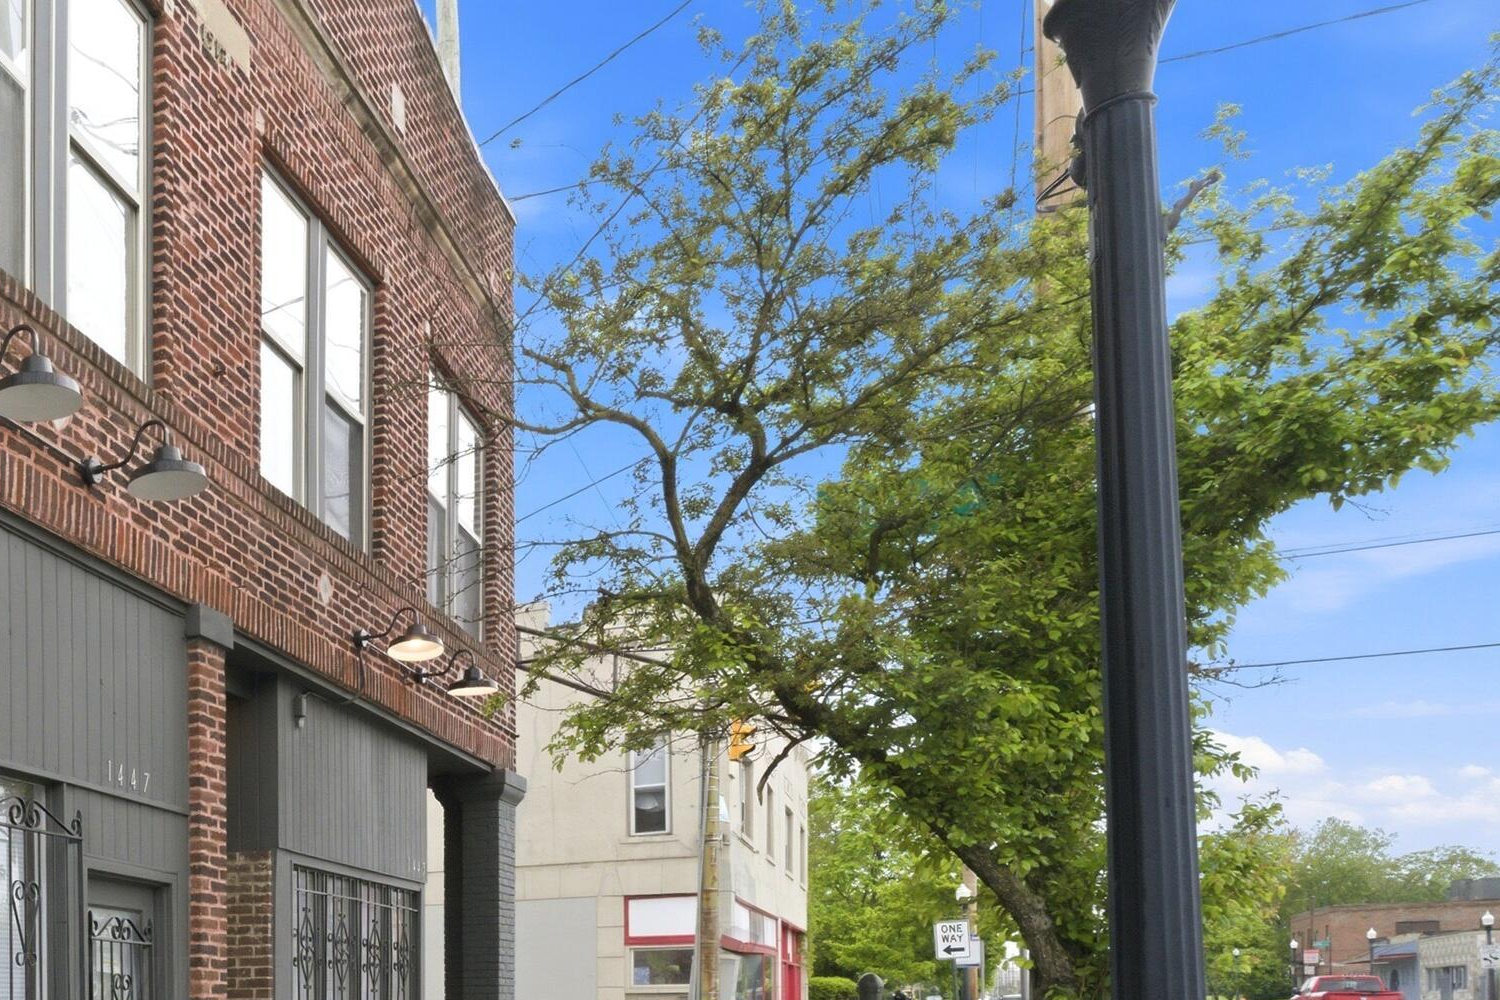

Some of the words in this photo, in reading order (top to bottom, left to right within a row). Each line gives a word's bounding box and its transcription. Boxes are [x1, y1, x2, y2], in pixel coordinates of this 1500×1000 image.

[108, 759, 150, 793] 1447
[940, 923, 962, 934] ONE
[941, 934, 964, 943] WAY
